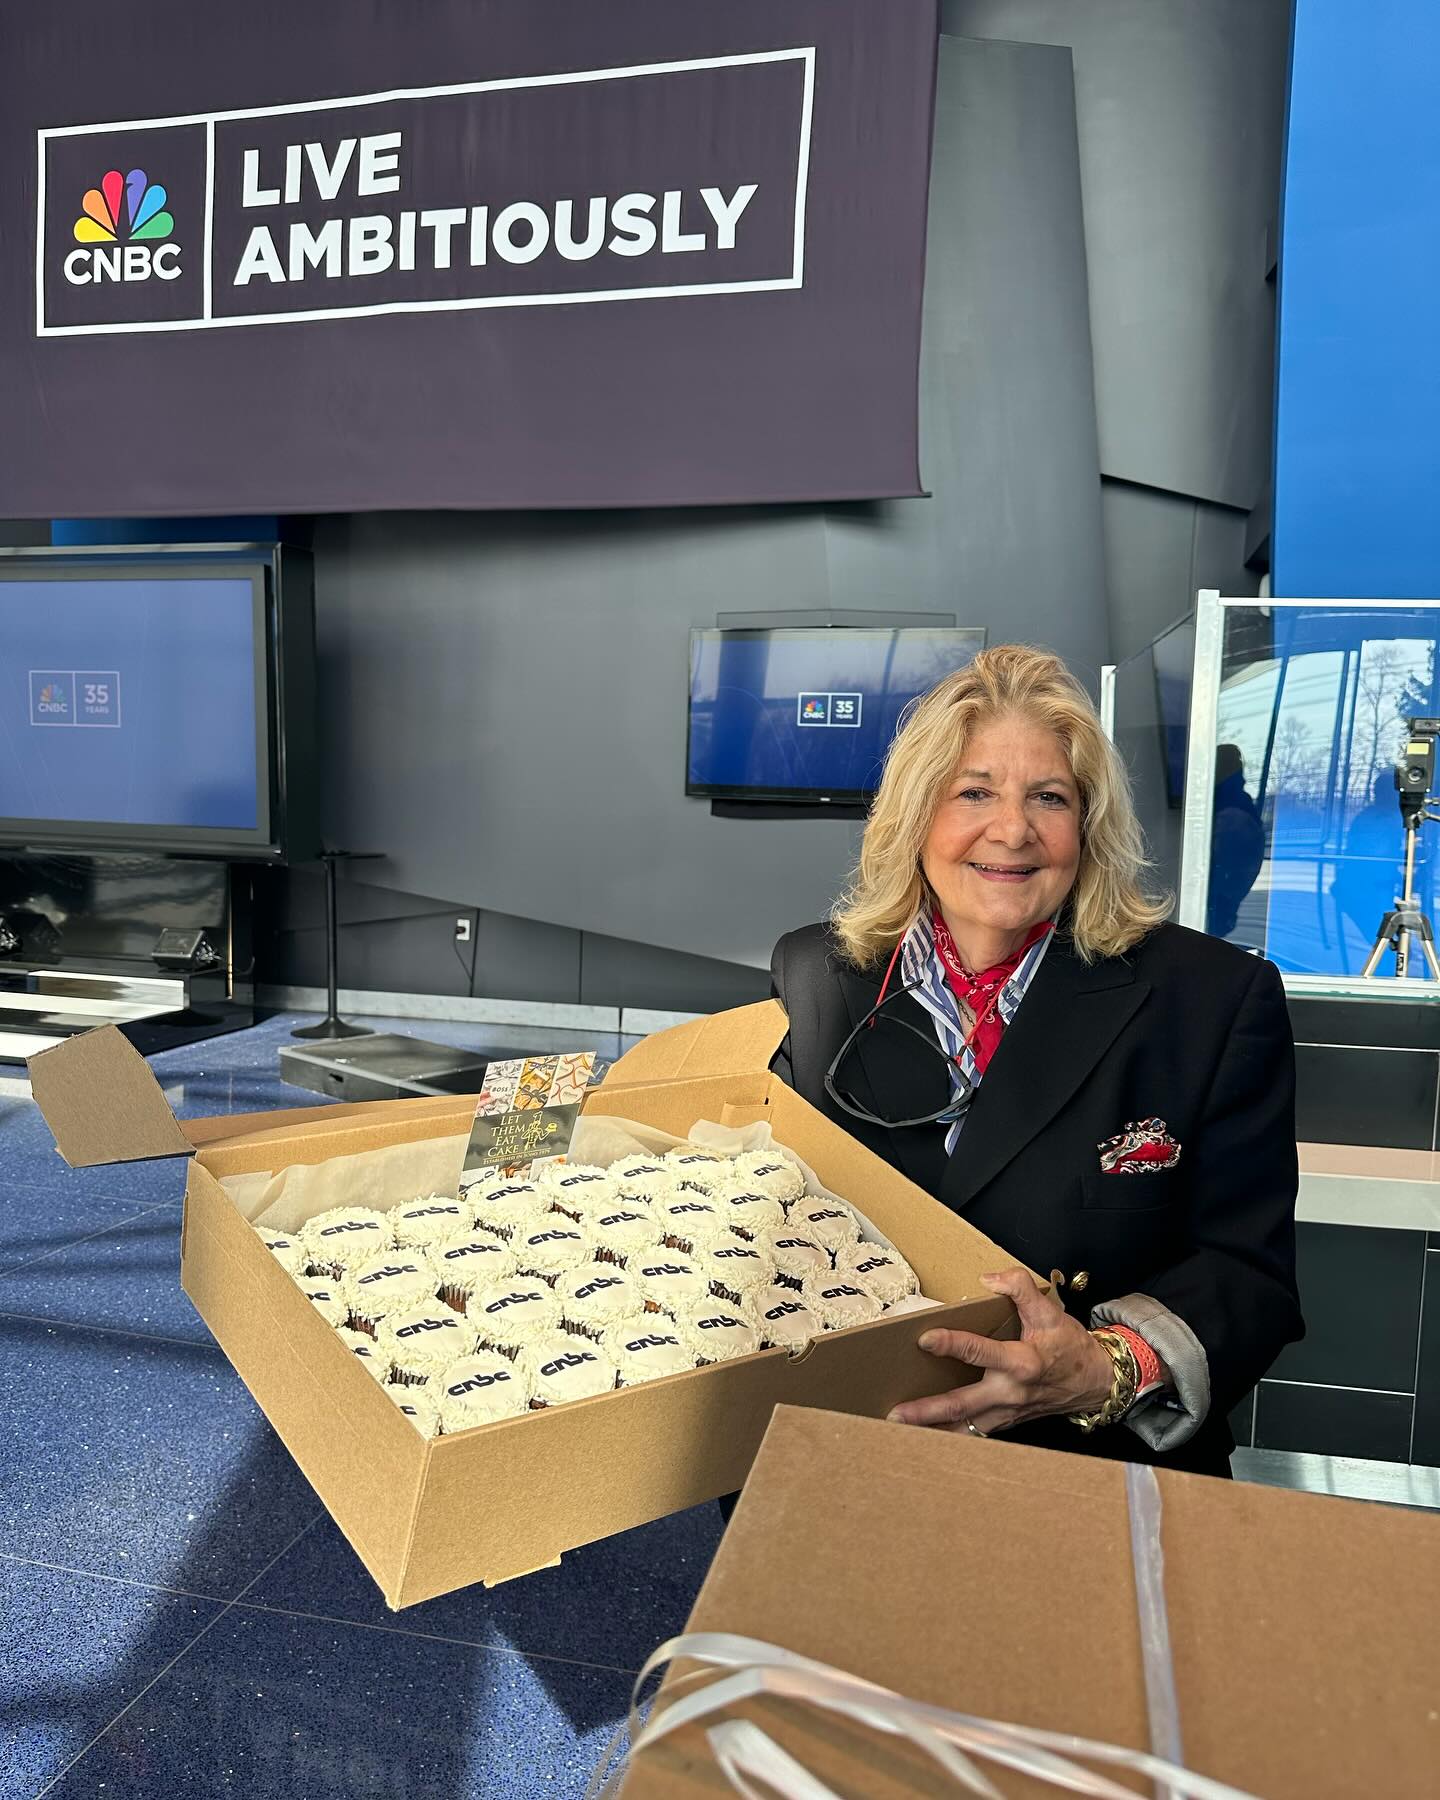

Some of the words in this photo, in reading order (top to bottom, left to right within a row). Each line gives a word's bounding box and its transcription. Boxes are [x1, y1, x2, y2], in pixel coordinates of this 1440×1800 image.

[242, 132, 402, 209] LIVE
[233, 184, 759, 286] AMBITIOUSLY
[63, 242, 183, 286] CNBC
[84, 683, 109, 705] 35
[38, 703, 68, 713] CNBC
[835, 700, 854, 714] 35
[501, 1115, 522, 1126] LET
[491, 1126, 526, 1137] THEM
[495, 1135, 518, 1147] EAT
[487, 1146, 519, 1158] CAKE
[678, 1154, 720, 1165] cnbc
[623, 1164, 667, 1178] cnbc
[753, 1164, 786, 1177] cnbc
[559, 1173, 605, 1187] cnbc
[485, 1185, 536, 1201] cnbc
[730, 1192, 770, 1205] cnbc
[402, 1206, 460, 1219] cnbc
[668, 1202, 716, 1215] cnbc
[807, 1208, 848, 1223] cnbc
[599, 1211, 649, 1226] cnbc
[320, 1221, 380, 1236] cnbc
[527, 1229, 582, 1246] cnbc
[775, 1237, 818, 1250] cnbc
[444, 1243, 502, 1260] cnbc
[713, 1246, 761, 1259] cnbc
[641, 1263, 694, 1277] cnbc
[855, 1255, 895, 1274] cnbc
[358, 1264, 419, 1284] cnbc
[574, 1276, 625, 1299] cnbc
[820, 1284, 867, 1299] cnbc
[485, 1291, 544, 1314] cnbc
[764, 1300, 808, 1321] cnbc
[395, 1318, 459, 1338] cnbc
[697, 1314, 750, 1330] cnbc
[625, 1333, 680, 1352] cnbc
[540, 1350, 598, 1377] cnbc
[447, 1370, 512, 1397] cnbc
